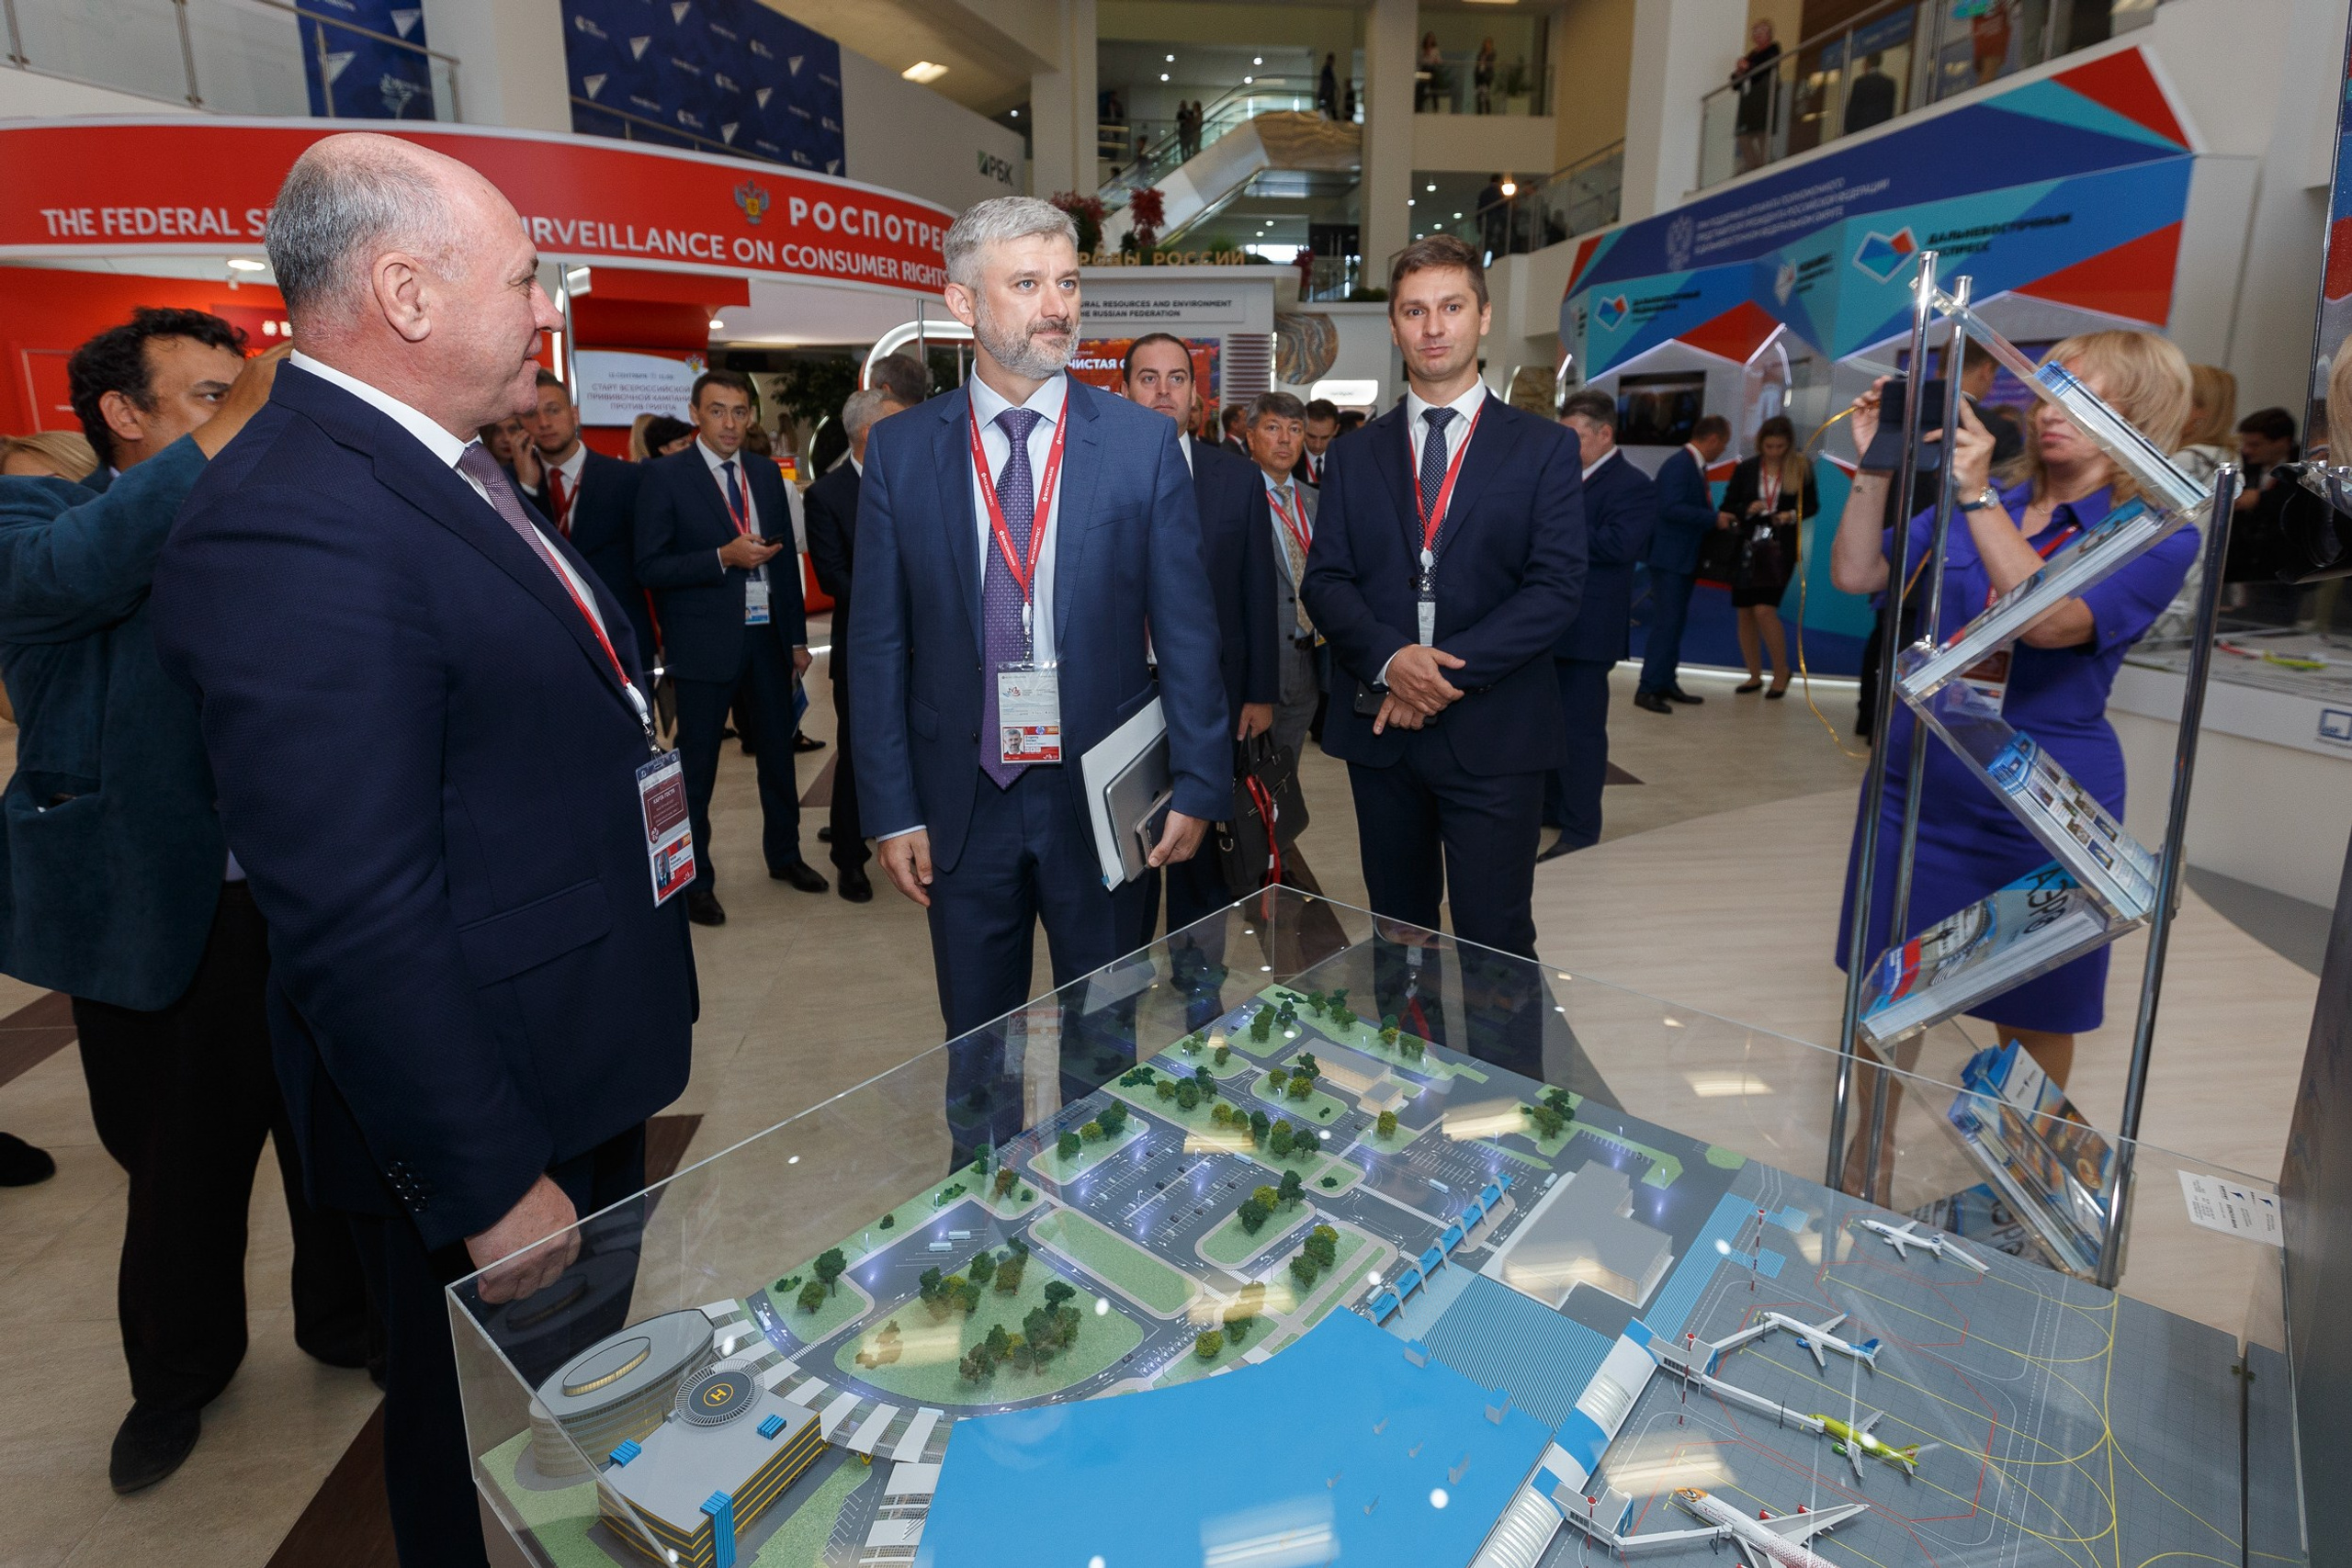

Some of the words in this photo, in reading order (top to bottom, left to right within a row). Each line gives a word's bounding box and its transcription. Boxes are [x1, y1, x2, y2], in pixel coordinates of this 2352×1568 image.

[40, 208, 96, 237] THE
[101, 207, 241, 235] FEDERAL
[788, 196, 948, 252] РОСПОТРЕ
[733, 237, 775, 265] ON
[782, 243, 899, 279] CONSUMER
[1152, 251, 1246, 266] РОССИИ
[1102, 299, 1150, 309] RESOURCES
[1152, 299, 1170, 309] AND
[1172, 299, 1233, 309] ENVIRONMENT
[1092, 310, 1127, 318] RUSSIAN
[1129, 310, 1182, 318] FEDERATION
[1068, 358, 1117, 370] ЧИСТАЯ
[710, 1388, 727, 1401] H
